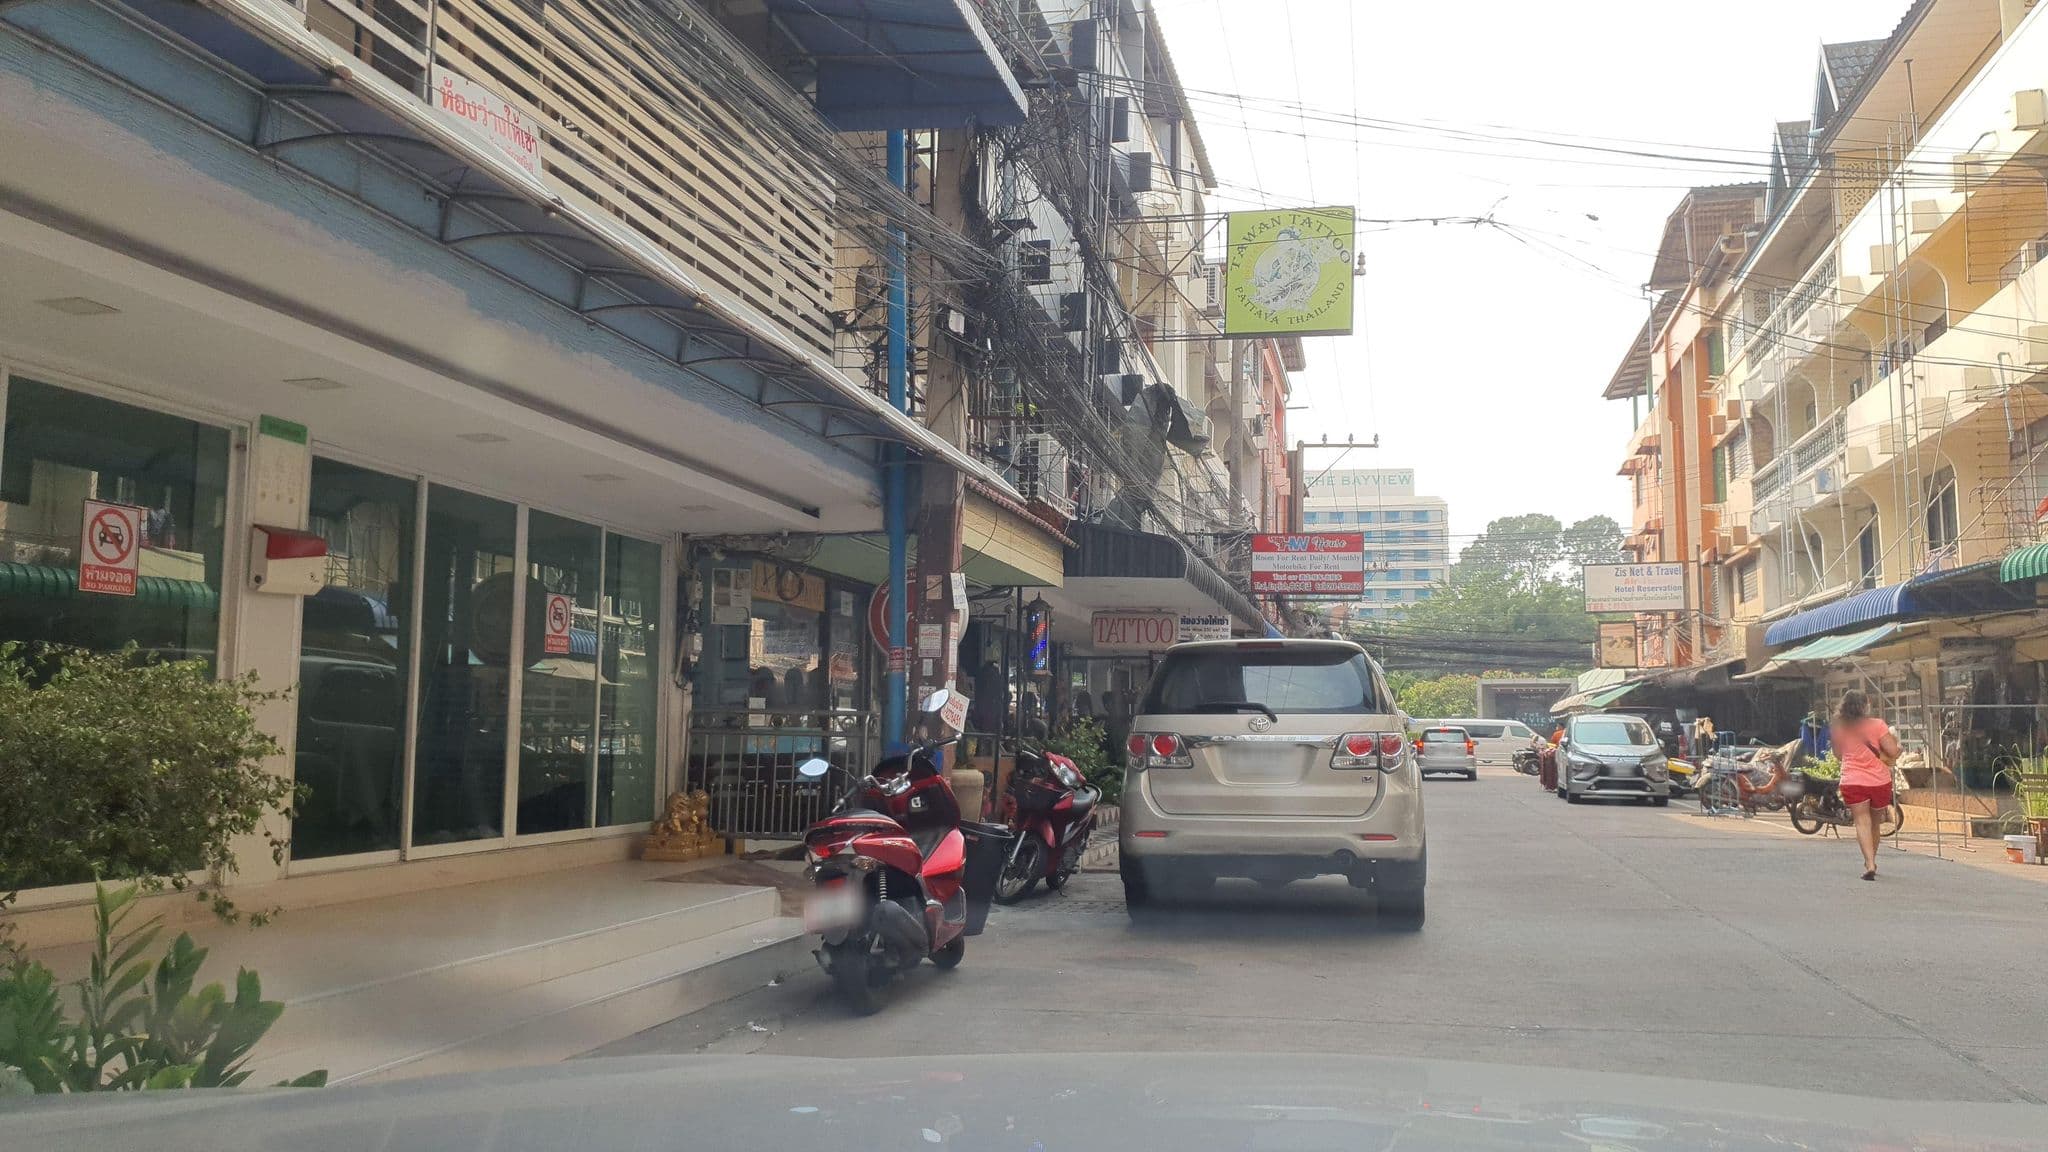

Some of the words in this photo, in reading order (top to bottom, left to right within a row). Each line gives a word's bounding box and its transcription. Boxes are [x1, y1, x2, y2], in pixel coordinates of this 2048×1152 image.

[1231, 216, 1281, 271] TAWAN
[1289, 213, 1351, 264] TATTOO
[1235, 286, 1279, 325] PATTAYA
[1287, 281, 1345, 325] THAILAND
[1305, 476, 1336, 486] THE
[1341, 474, 1412, 486] BAYVIEW
[1311, 535, 1347, 552] House
[1332, 554, 1360, 563] Monthly
[85, 568, 132, 584] ห้ามจอด
[1615, 567, 1627, 577] Zis
[1629, 567, 1645, 577] Net
[1646, 567, 1653, 576] &
[1655, 565, 1682, 576] Travel
[98, 583, 132, 592] PARKING
[1614, 585, 1635, 593] Hotel
[1095, 617, 1174, 643] TATTOO
